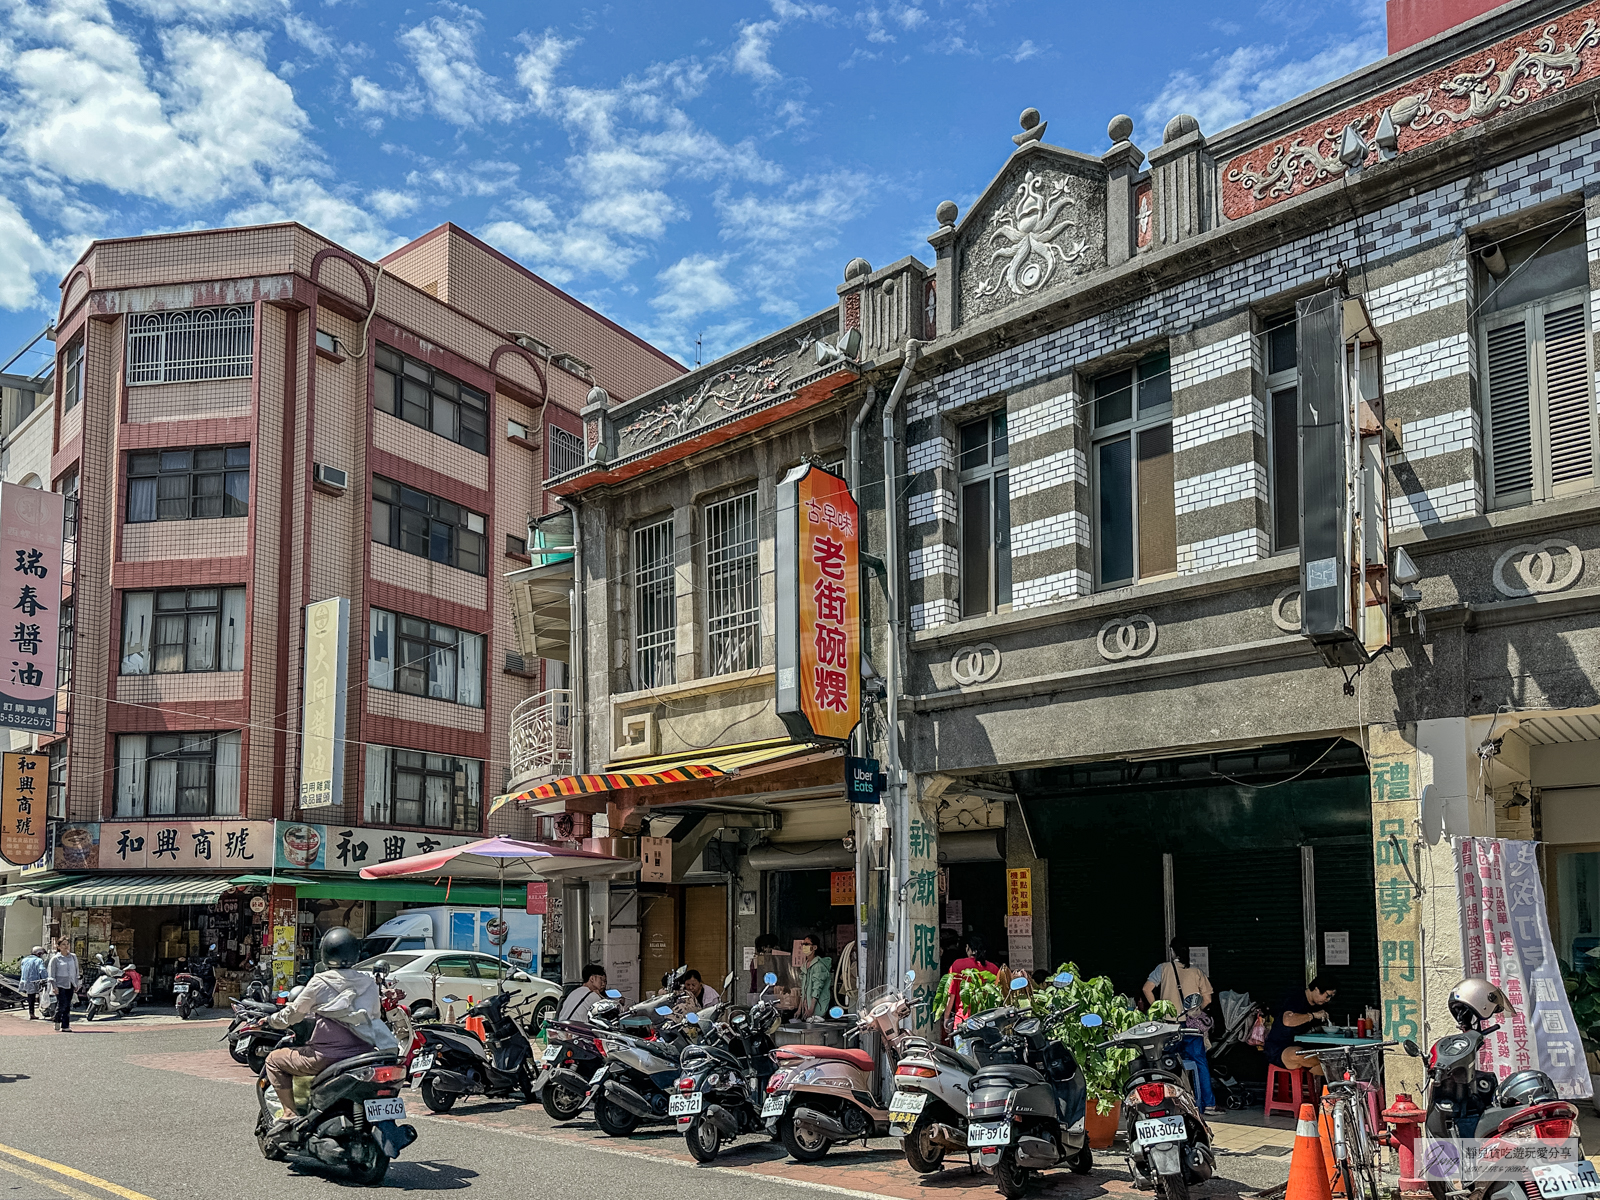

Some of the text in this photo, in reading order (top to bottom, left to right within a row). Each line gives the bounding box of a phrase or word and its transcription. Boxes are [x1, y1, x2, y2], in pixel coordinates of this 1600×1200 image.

[805, 497, 854, 537] 古早味
[9, 547, 48, 687] 瑞春醬油
[812, 535, 849, 714] 老街碗粿
[309, 642, 331, 776] 大同醬油
[301, 780, 331, 793] 日用雜貨
[853, 767, 873, 782] Uber
[854, 780, 874, 793] Eats
[16, 756, 36, 836] 和興商號
[116, 828, 254, 861] 和興商號
[1372, 761, 1418, 1046] 禮品專門店
[909, 820, 938, 1031] 新潮服飾
[367, 1103, 403, 1116] NHF-6269
[670, 1099, 700, 1112] H6S-721
[969, 1127, 1009, 1141] NHF-5916
[1138, 1121, 1184, 1140] NBX-3026
[1539, 1170, 1598, 1195] 231-PHT
